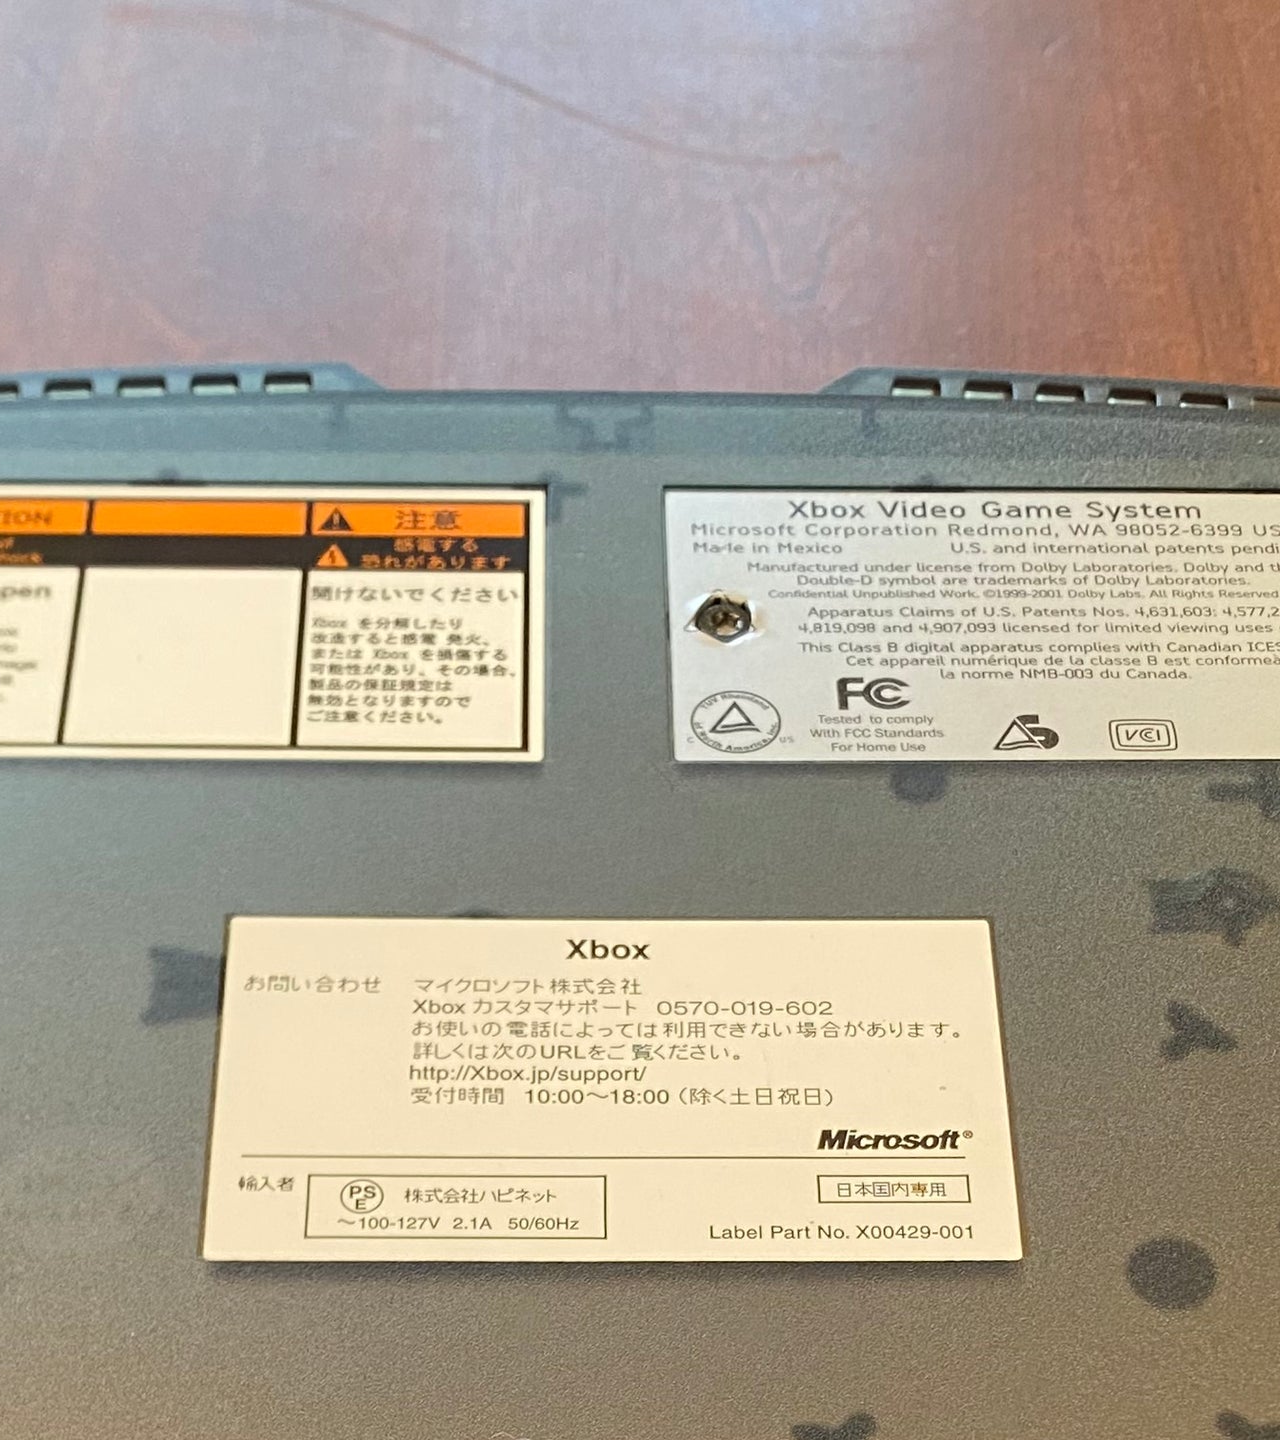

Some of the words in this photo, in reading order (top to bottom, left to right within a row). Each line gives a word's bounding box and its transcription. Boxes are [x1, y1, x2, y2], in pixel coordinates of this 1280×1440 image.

[788, 500, 865, 518] Xbox
[877, 500, 966, 519] Video
[981, 501, 1072, 519] Game
[1086, 501, 1201, 523] System
[395, 510, 462, 530] 注意
[691, 523, 795, 536] Microsoft
[805, 523, 937, 539] Corporation
[948, 523, 1059, 538] Redmond,
[1068, 523, 1108, 536] WA
[1115, 524, 1243, 537] 98052-6399
[752, 542, 770, 554] in
[777, 542, 843, 554] Mexico
[950, 542, 986, 554] U.S.
[992, 542, 1026, 554] and
[1033, 542, 1150, 554] international
[1155, 544, 1225, 557] patents
[361, 554, 510, 570] 恐れがあります
[747, 562, 859, 573] Manufactured
[864, 562, 912, 573] under
[916, 562, 972, 573] license
[978, 562, 1016, 573] from
[1021, 562, 1068, 576] Dolby
[1072, 562, 1178, 573] Laboratories.
[1183, 562, 1229, 576] Dolby
[1234, 562, 1264, 573] and
[797, 574, 873, 586] Double-D
[878, 574, 936, 588] symbol
[942, 577, 968, 586] are
[973, 574, 1067, 586] trademarks
[1073, 574, 1089, 586] of
[1094, 574, 1140, 588] Dolby
[1145, 574, 1250, 586] Laboratories.
[310, 585, 519, 602] 開けないでください
[808, 606, 894, 620] Apparatus
[899, 606, 955, 618] Claims
[960, 606, 977, 617] of
[983, 606, 1016, 618] U.S.
[1022, 606, 1087, 617] Patents
[1093, 606, 1130, 617] Nos.
[882, 623, 913, 633] and
[918, 622, 996, 635] 4,907,093
[1002, 622, 1070, 633] licensed
[1076, 622, 1100, 633] for
[1104, 622, 1162, 633] limited
[1167, 622, 1229, 636] viewing
[1235, 624, 1274, 633] uses
[799, 642, 832, 653] This
[838, 642, 882, 653] Class
[887, 642, 898, 653] B
[904, 642, 955, 656] digital
[960, 643, 1043, 655] apparatus
[1048, 641, 1120, 655] complies
[1125, 642, 1161, 653] with
[1166, 642, 1242, 653] Canadian
[846, 655, 874, 666] Cet
[879, 656, 946, 669] appareil
[950, 654, 1038, 668] numérique
[1044, 655, 1064, 666] de
[1068, 654, 1086, 666] la
[1090, 654, 1142, 666] classe
[1146, 655, 1158, 666] B
[1164, 656, 1191, 666] est
[940, 668, 955, 680] la
[961, 671, 1014, 680] norme
[1020, 668, 1094, 680] NMB-003
[1099, 668, 1120, 679] du
[1126, 668, 1192, 680] Canada.
[836, 677, 910, 710] FCC
[817, 714, 862, 725] Tested
[869, 715, 883, 725] to
[886, 714, 934, 726] comply
[809, 728, 841, 738] With
[844, 728, 872, 738] FCC
[874, 728, 945, 738] Standards
[830, 742, 854, 752] For
[856, 742, 897, 752] Home
[900, 742, 926, 752] Use
[566, 939, 650, 960] Xbox
[244, 975, 382, 994] お問い合わせ
[414, 978, 642, 995] マイクロソフト株式会社
[412, 999, 466, 1014] Xbox
[473, 998, 636, 1016] カスタマサポート
[656, 1000, 833, 1016] 0570-019-602
[411, 1020, 960, 1039] お使いの電話によっては利用できない場合があります。
[413, 1042, 740, 1061] 詳しくは次のURLをご覧ください。
[409, 1064, 647, 1084] http://Xbox.jp/support/
[410, 1086, 505, 1105] 受付時間
[238, 1175, 294, 1192] 輸入者
[837, 1181, 947, 1198] 日本国内専用
[404, 1187, 557, 1204] 株式会社ハピネット
[452, 1217, 492, 1230] 2.1A
[508, 1216, 579, 1230] 50/60Hz
[710, 1225, 762, 1240] Label
[771, 1225, 811, 1240] Part
[818, 1225, 850, 1239] No.
[856, 1225, 973, 1240] X00429-001
